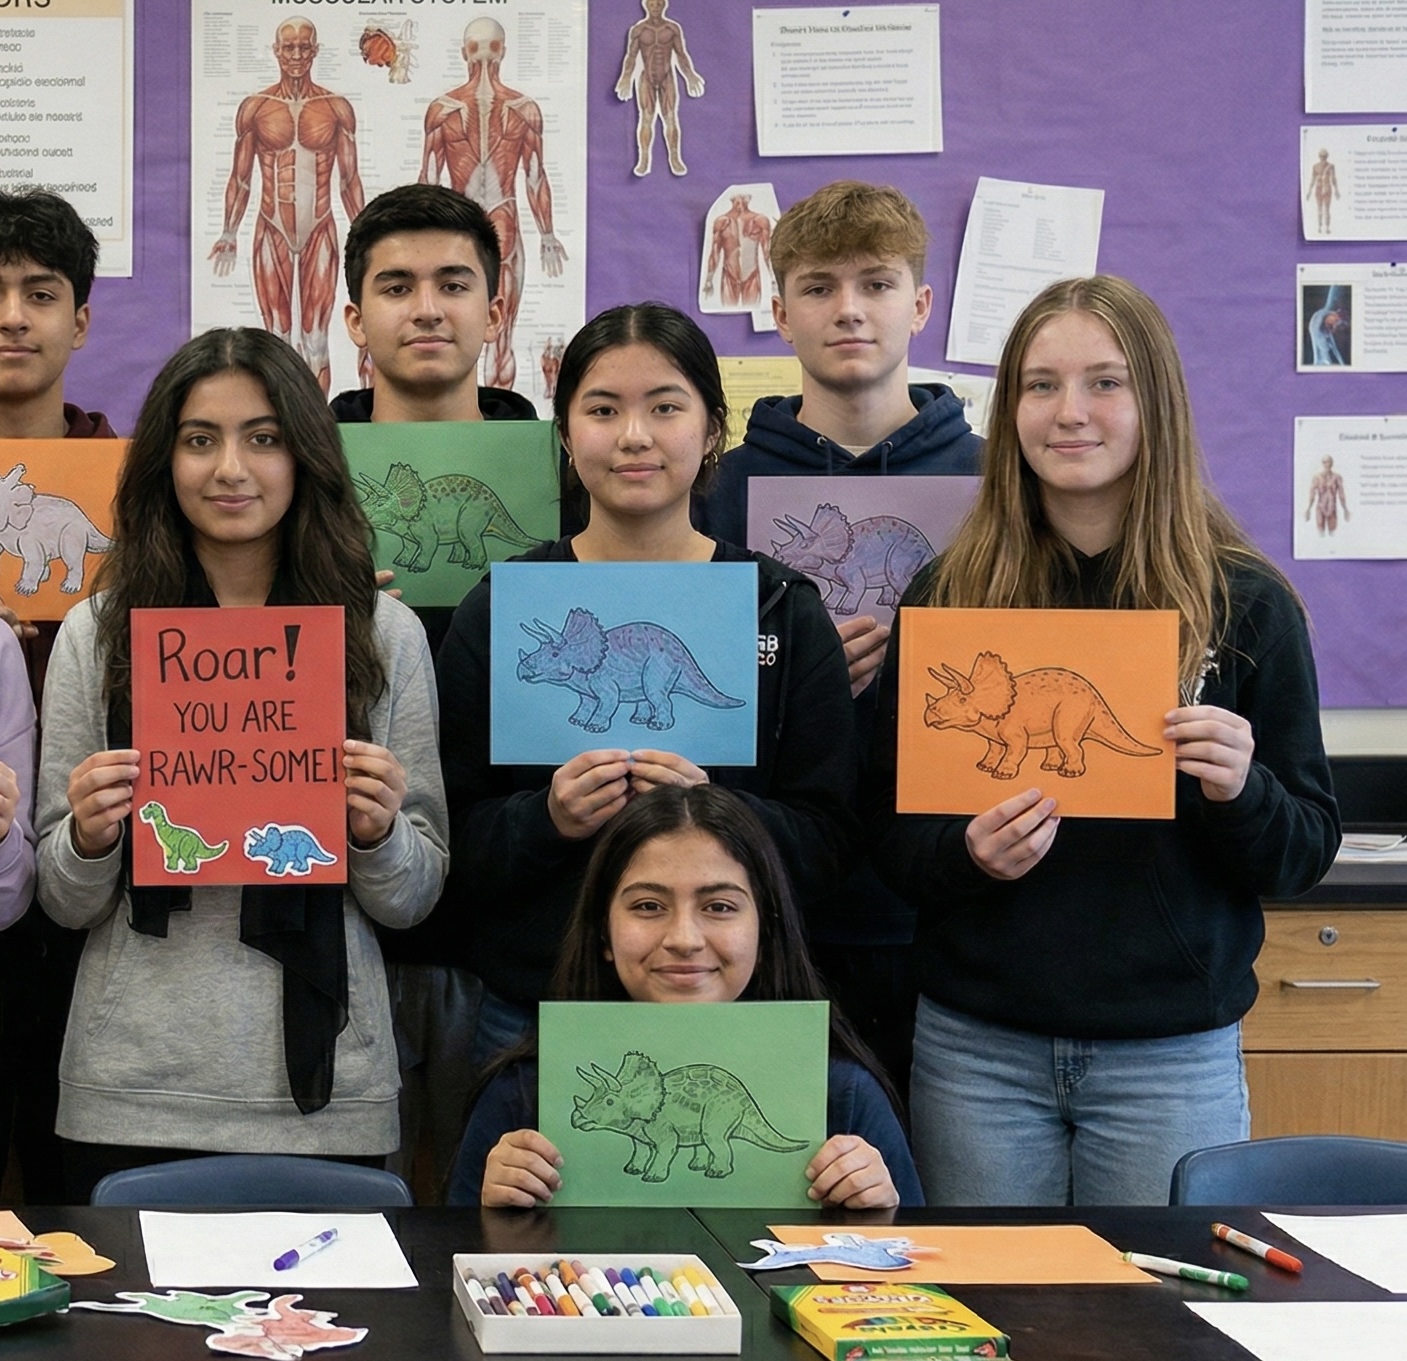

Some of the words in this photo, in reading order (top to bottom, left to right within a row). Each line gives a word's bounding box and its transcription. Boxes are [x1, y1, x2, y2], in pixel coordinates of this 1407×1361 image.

[158, 625, 301, 683] Roar!
[173, 701, 229, 734] YOU
[241, 700, 298, 733] ARE
[149, 747, 339, 787] RAWR-SOME!
